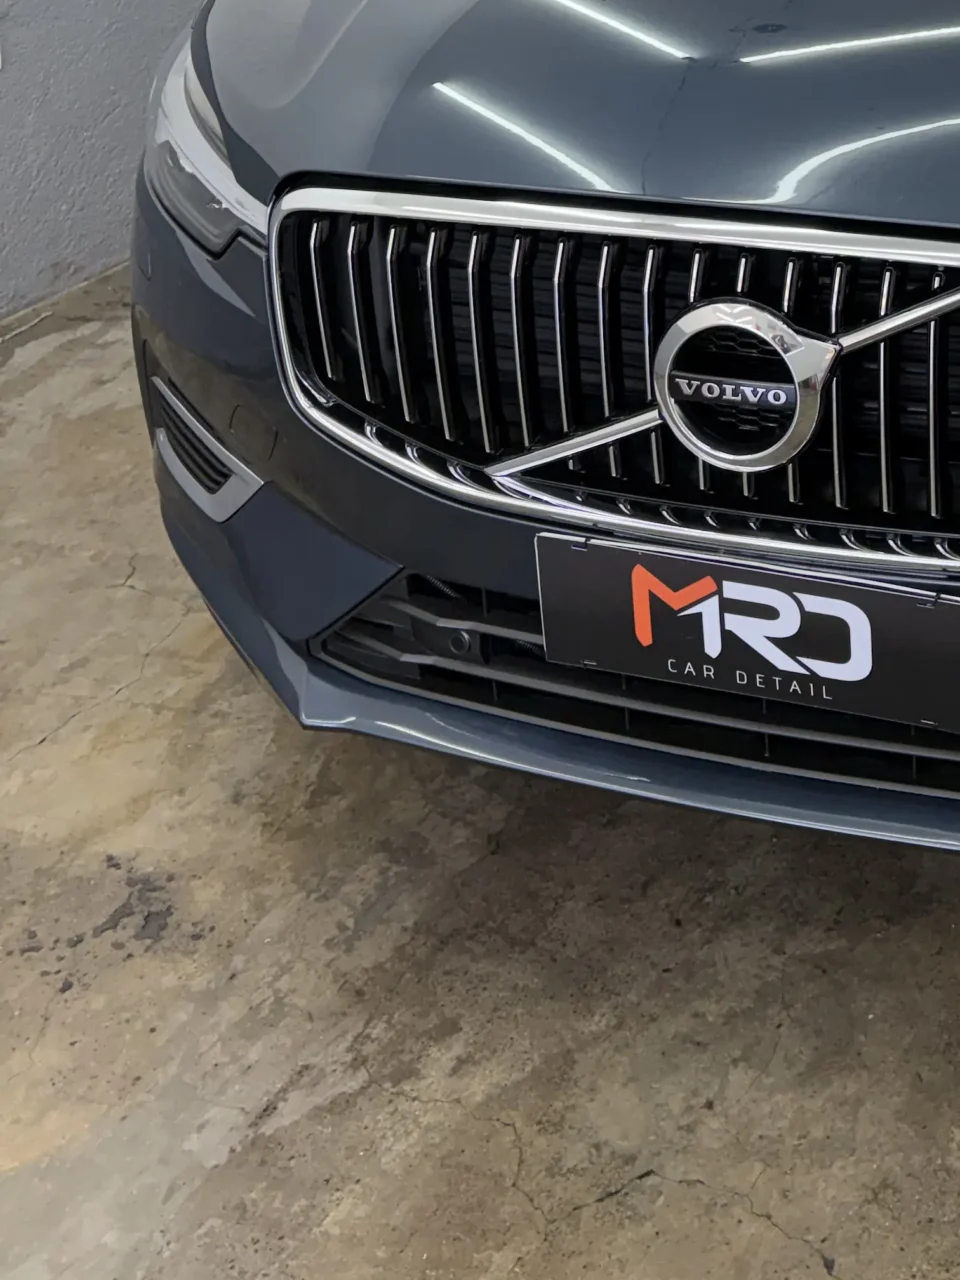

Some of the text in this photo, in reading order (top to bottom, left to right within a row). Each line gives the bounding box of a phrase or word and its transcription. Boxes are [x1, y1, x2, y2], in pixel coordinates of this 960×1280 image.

[675, 378, 787, 405] VOLVO
[667, 658, 833, 700] CAR DETAIL
